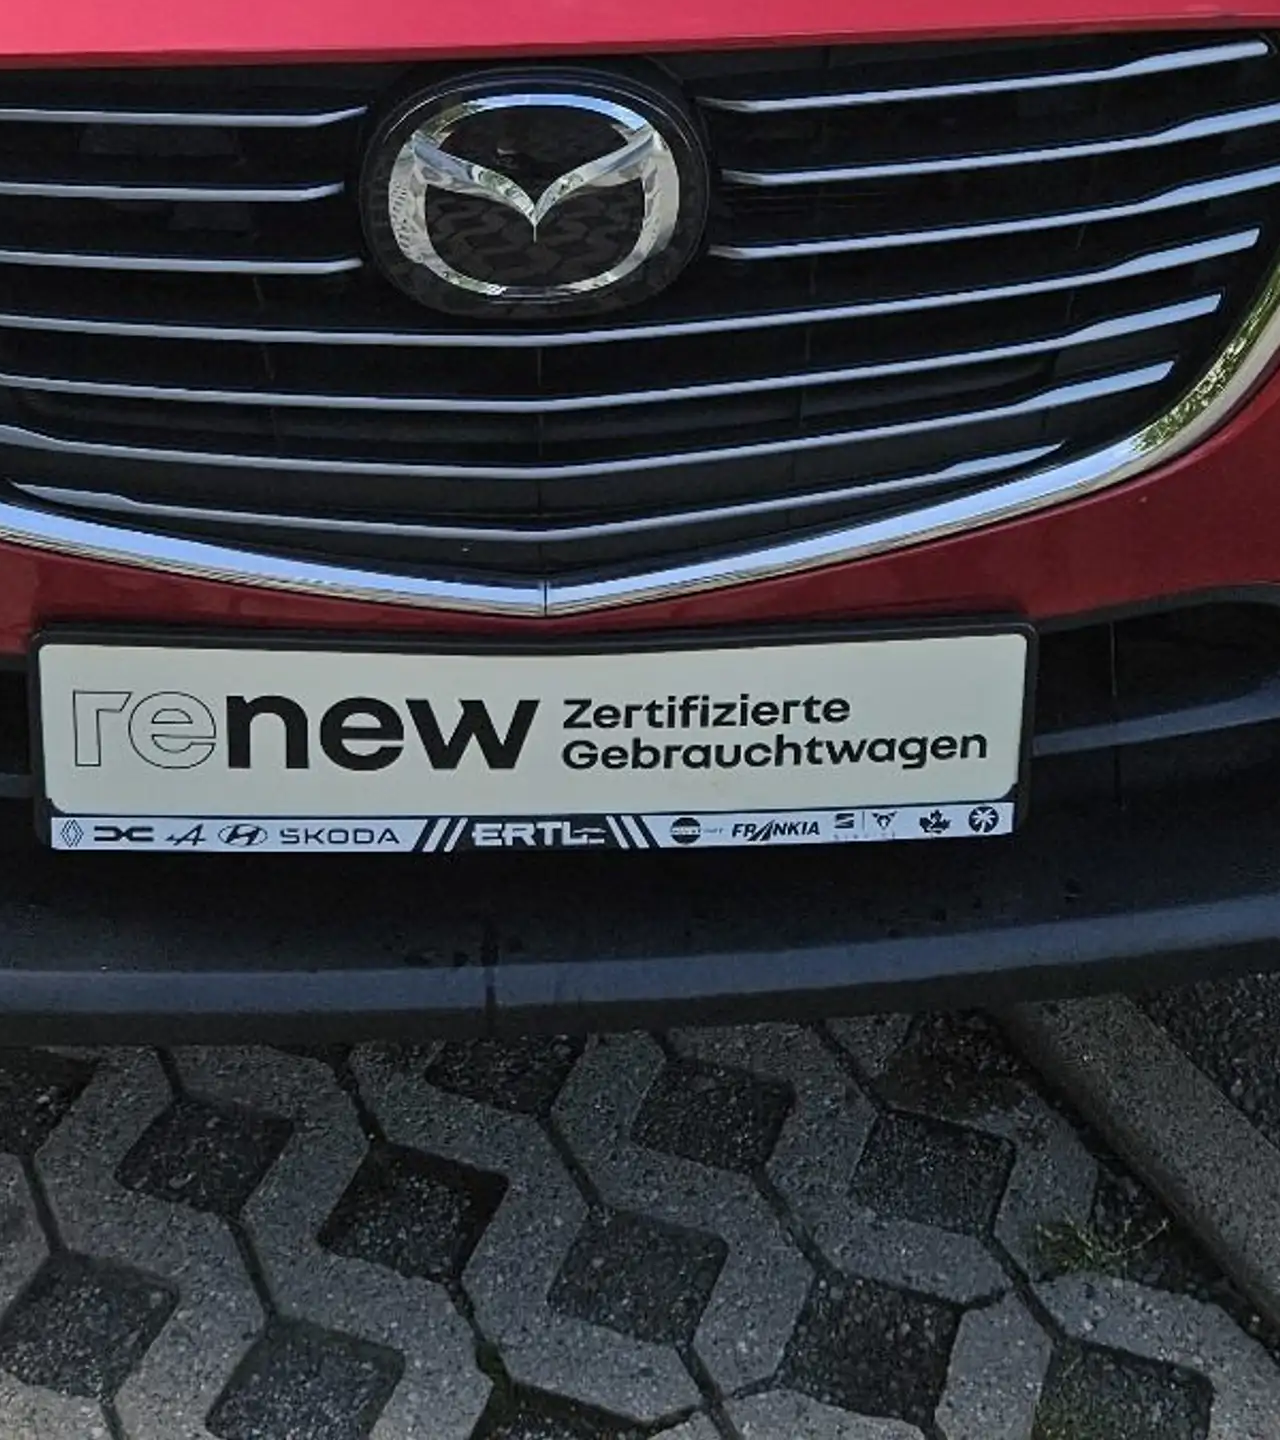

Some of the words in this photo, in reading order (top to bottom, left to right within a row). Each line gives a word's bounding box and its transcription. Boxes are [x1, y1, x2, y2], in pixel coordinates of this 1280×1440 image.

[73, 690, 541, 771] renew
[563, 693, 851, 730] Zertifizierte
[561, 733, 989, 771] Gebrauchtwagen
